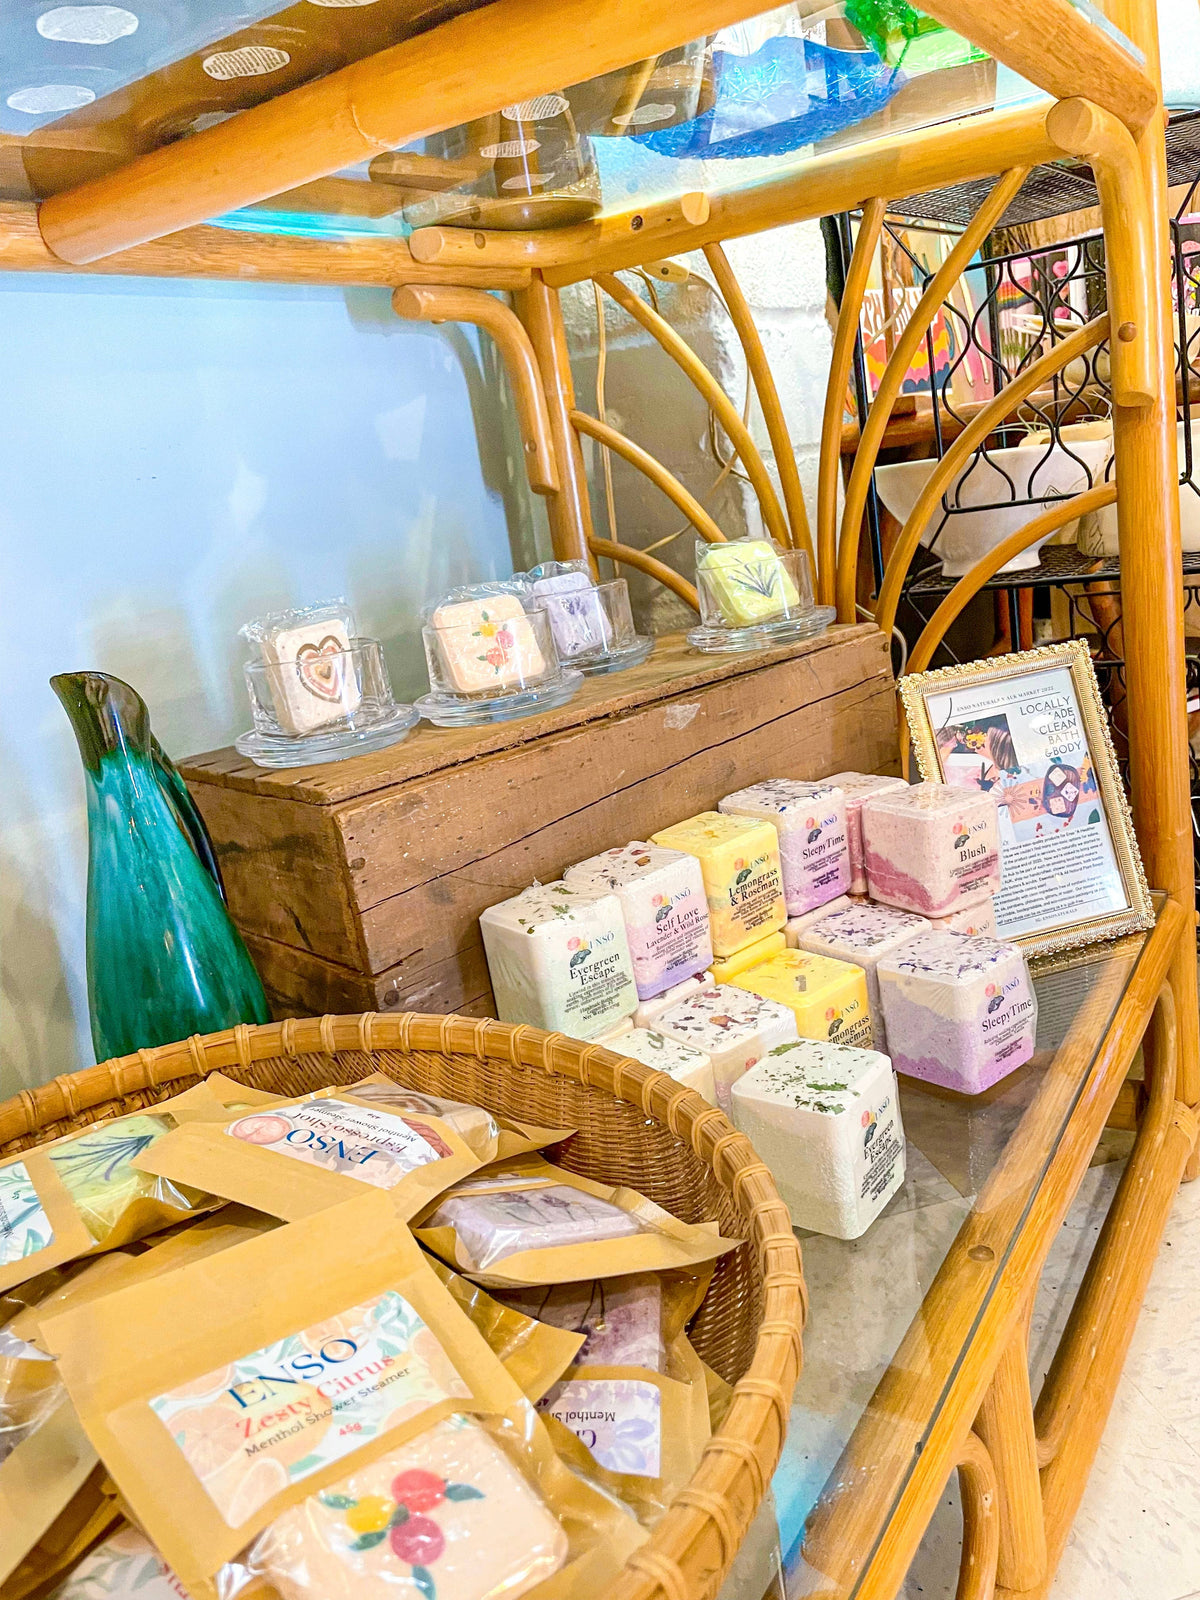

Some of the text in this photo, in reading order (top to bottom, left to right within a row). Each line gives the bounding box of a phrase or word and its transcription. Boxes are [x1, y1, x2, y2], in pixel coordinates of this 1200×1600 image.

[1020, 696, 1071, 716] LOCALLY
[1039, 718, 1077, 735] CLEAN
[1048, 729, 1080, 745] BATH
[960, 844, 987, 862] Blush
[728, 868, 778, 898] Lemongrass
[731, 896, 738, 907] &
[741, 876, 779, 902] Rosemary
[646, 931, 673, 950] Lavender
[680, 920, 695, 931] Wild
[656, 908, 699, 935] Self Love
[569, 953, 620, 980] Evergreen
[580, 965, 616, 986] Escape
[292, 1111, 408, 1153] Espresso Shot
[309, 1107, 417, 1143] Menthol Shower Steamer
[864, 1120, 894, 1160] Evergreen
[236, 1355, 396, 1439] Zesty Citrus
[244, 1367, 411, 1458] Menthol Shower Steamer
[565, 1410, 616, 1423] Menthol
[339, 1422, 363, 1437] 45g
